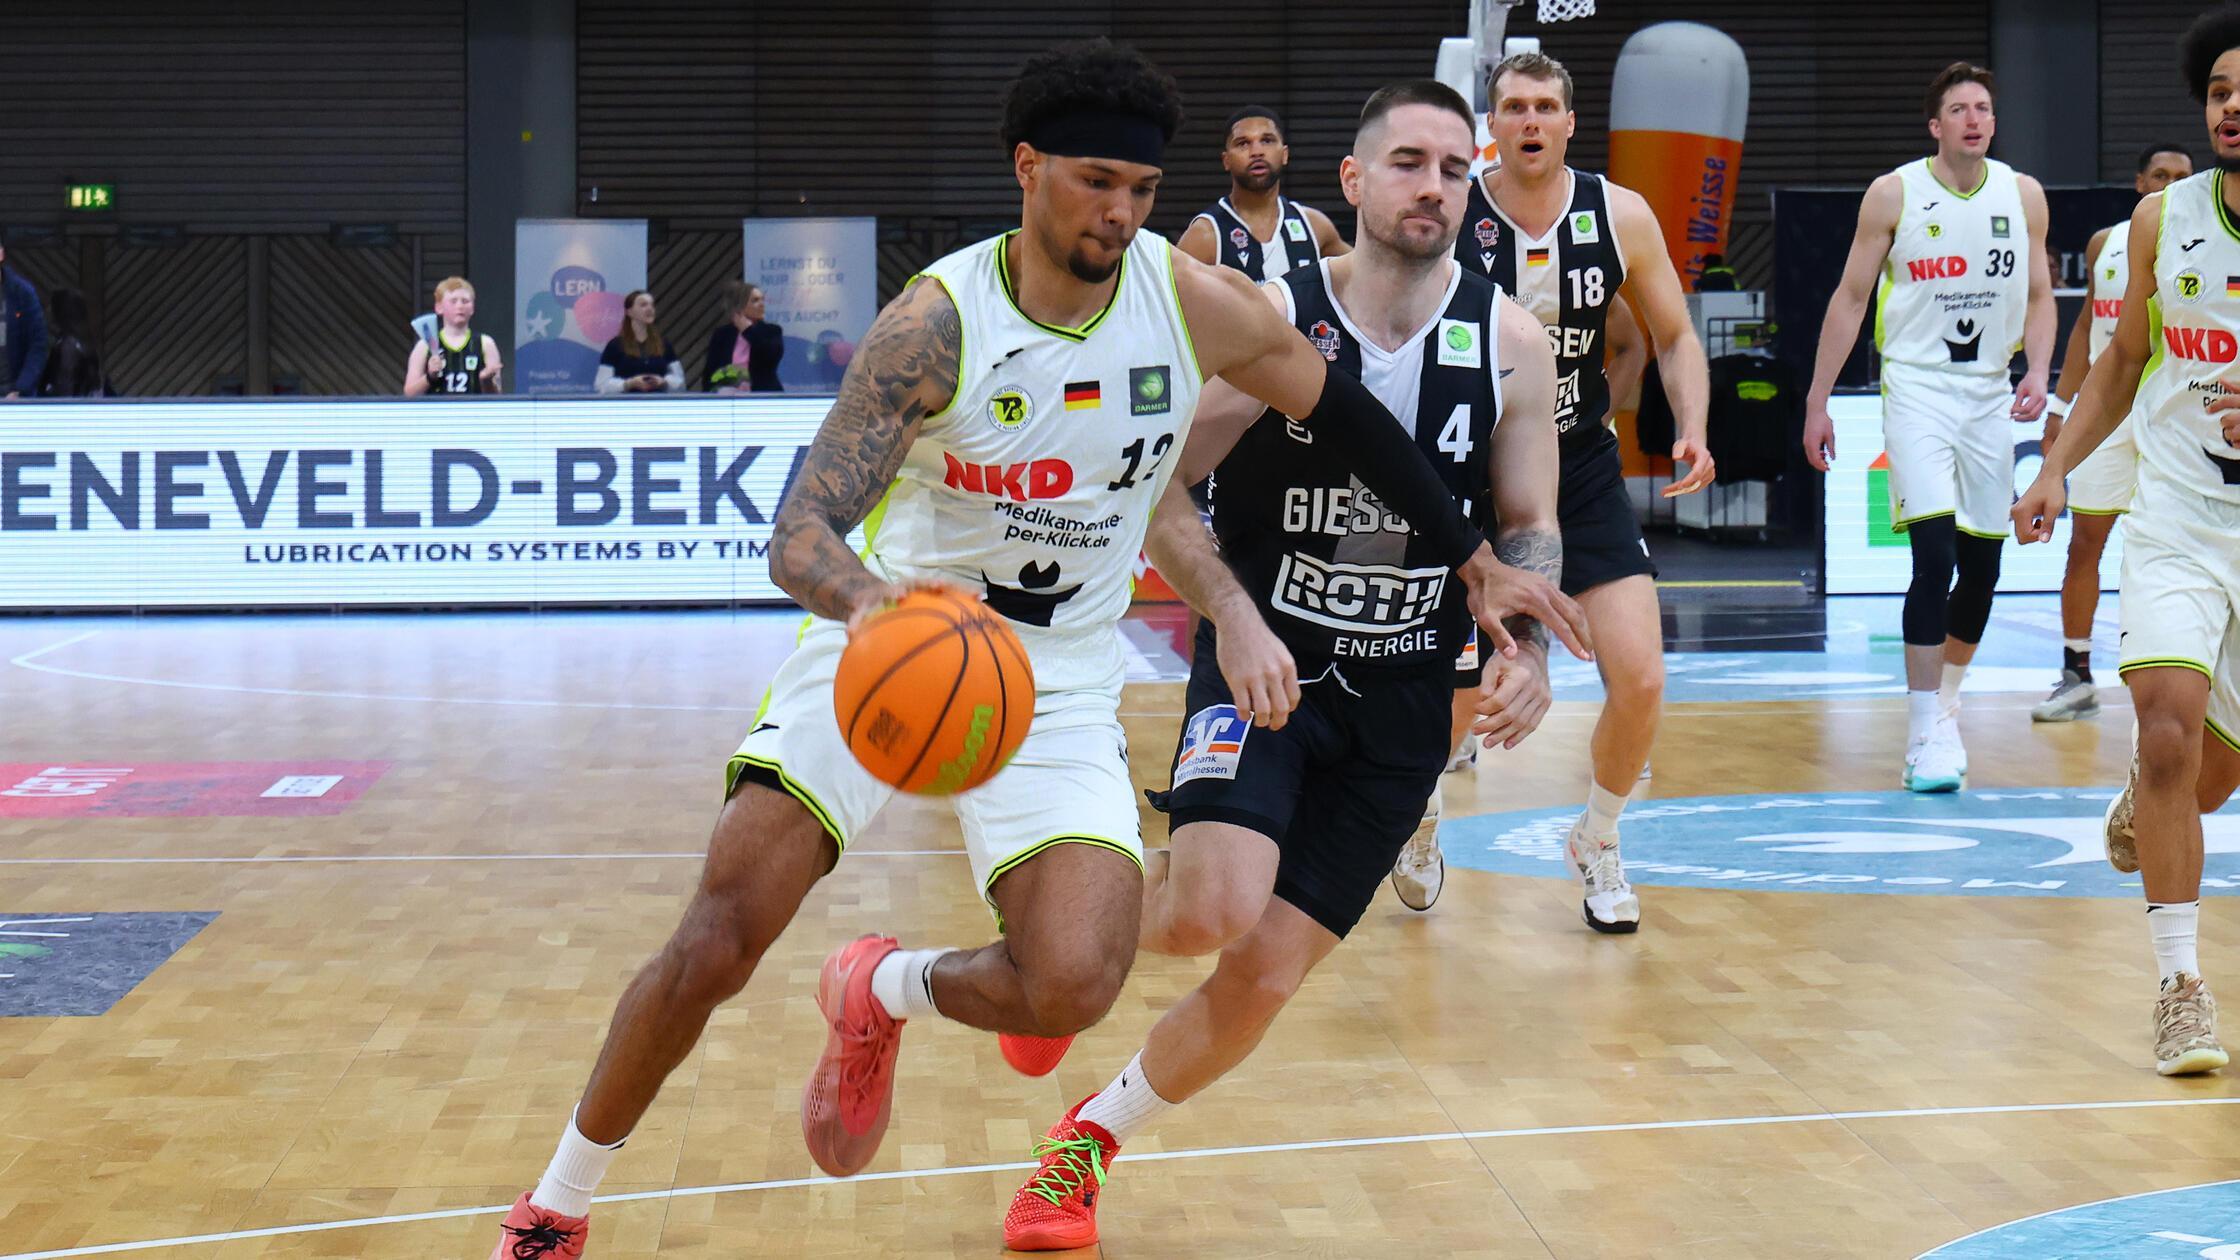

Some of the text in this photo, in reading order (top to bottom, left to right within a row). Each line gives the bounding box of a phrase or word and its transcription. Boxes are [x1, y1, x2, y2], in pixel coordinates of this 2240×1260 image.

[1686, 157, 1727, 242] Weisse
[1907, 255, 1968, 282] NKD
[1985, 248, 2015, 278] 39
[1567, 266, 1605, 310] 18
[2163, 326, 2239, 364] NKD
[446, 372, 469, 393] 12
[1436, 403, 1474, 463] 4
[943, 450, 1074, 502] NKD
[246, 540, 770, 564] LUBRICATION SYSTEMS BY TIM
[1003, 524, 1111, 548] per-Klick.de
[1286, 566, 1440, 623] ROTH
[1333, 630, 1438, 658] ENERGIE
